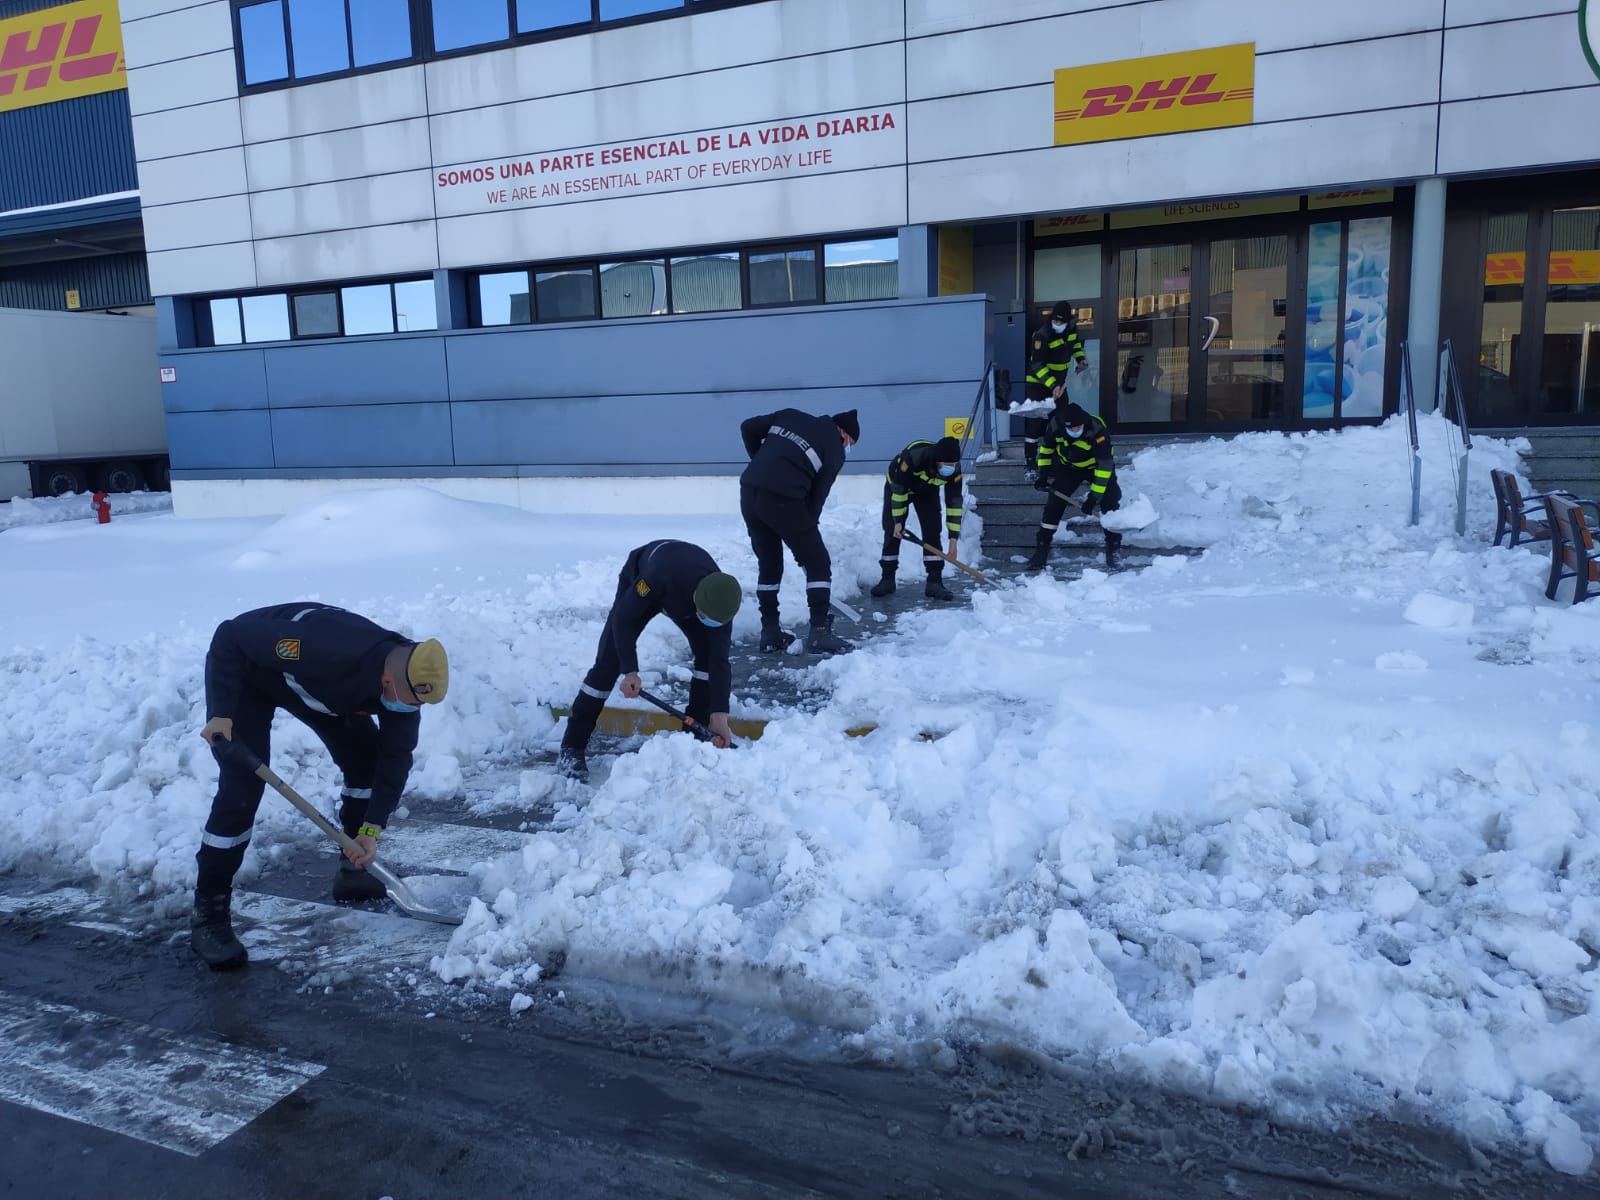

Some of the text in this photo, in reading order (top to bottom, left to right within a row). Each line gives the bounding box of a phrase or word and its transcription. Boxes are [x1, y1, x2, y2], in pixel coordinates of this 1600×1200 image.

[0, 14, 118, 96] HL
[1080, 73, 1225, 118] DHL
[438, 112, 895, 187] SOMOS UNA PARTE ESENCIAL DE LA VIDA DIARIA
[487, 149, 833, 204] WE ARE AN ESSENTIAL PART OF EVERYDAY LIFE
